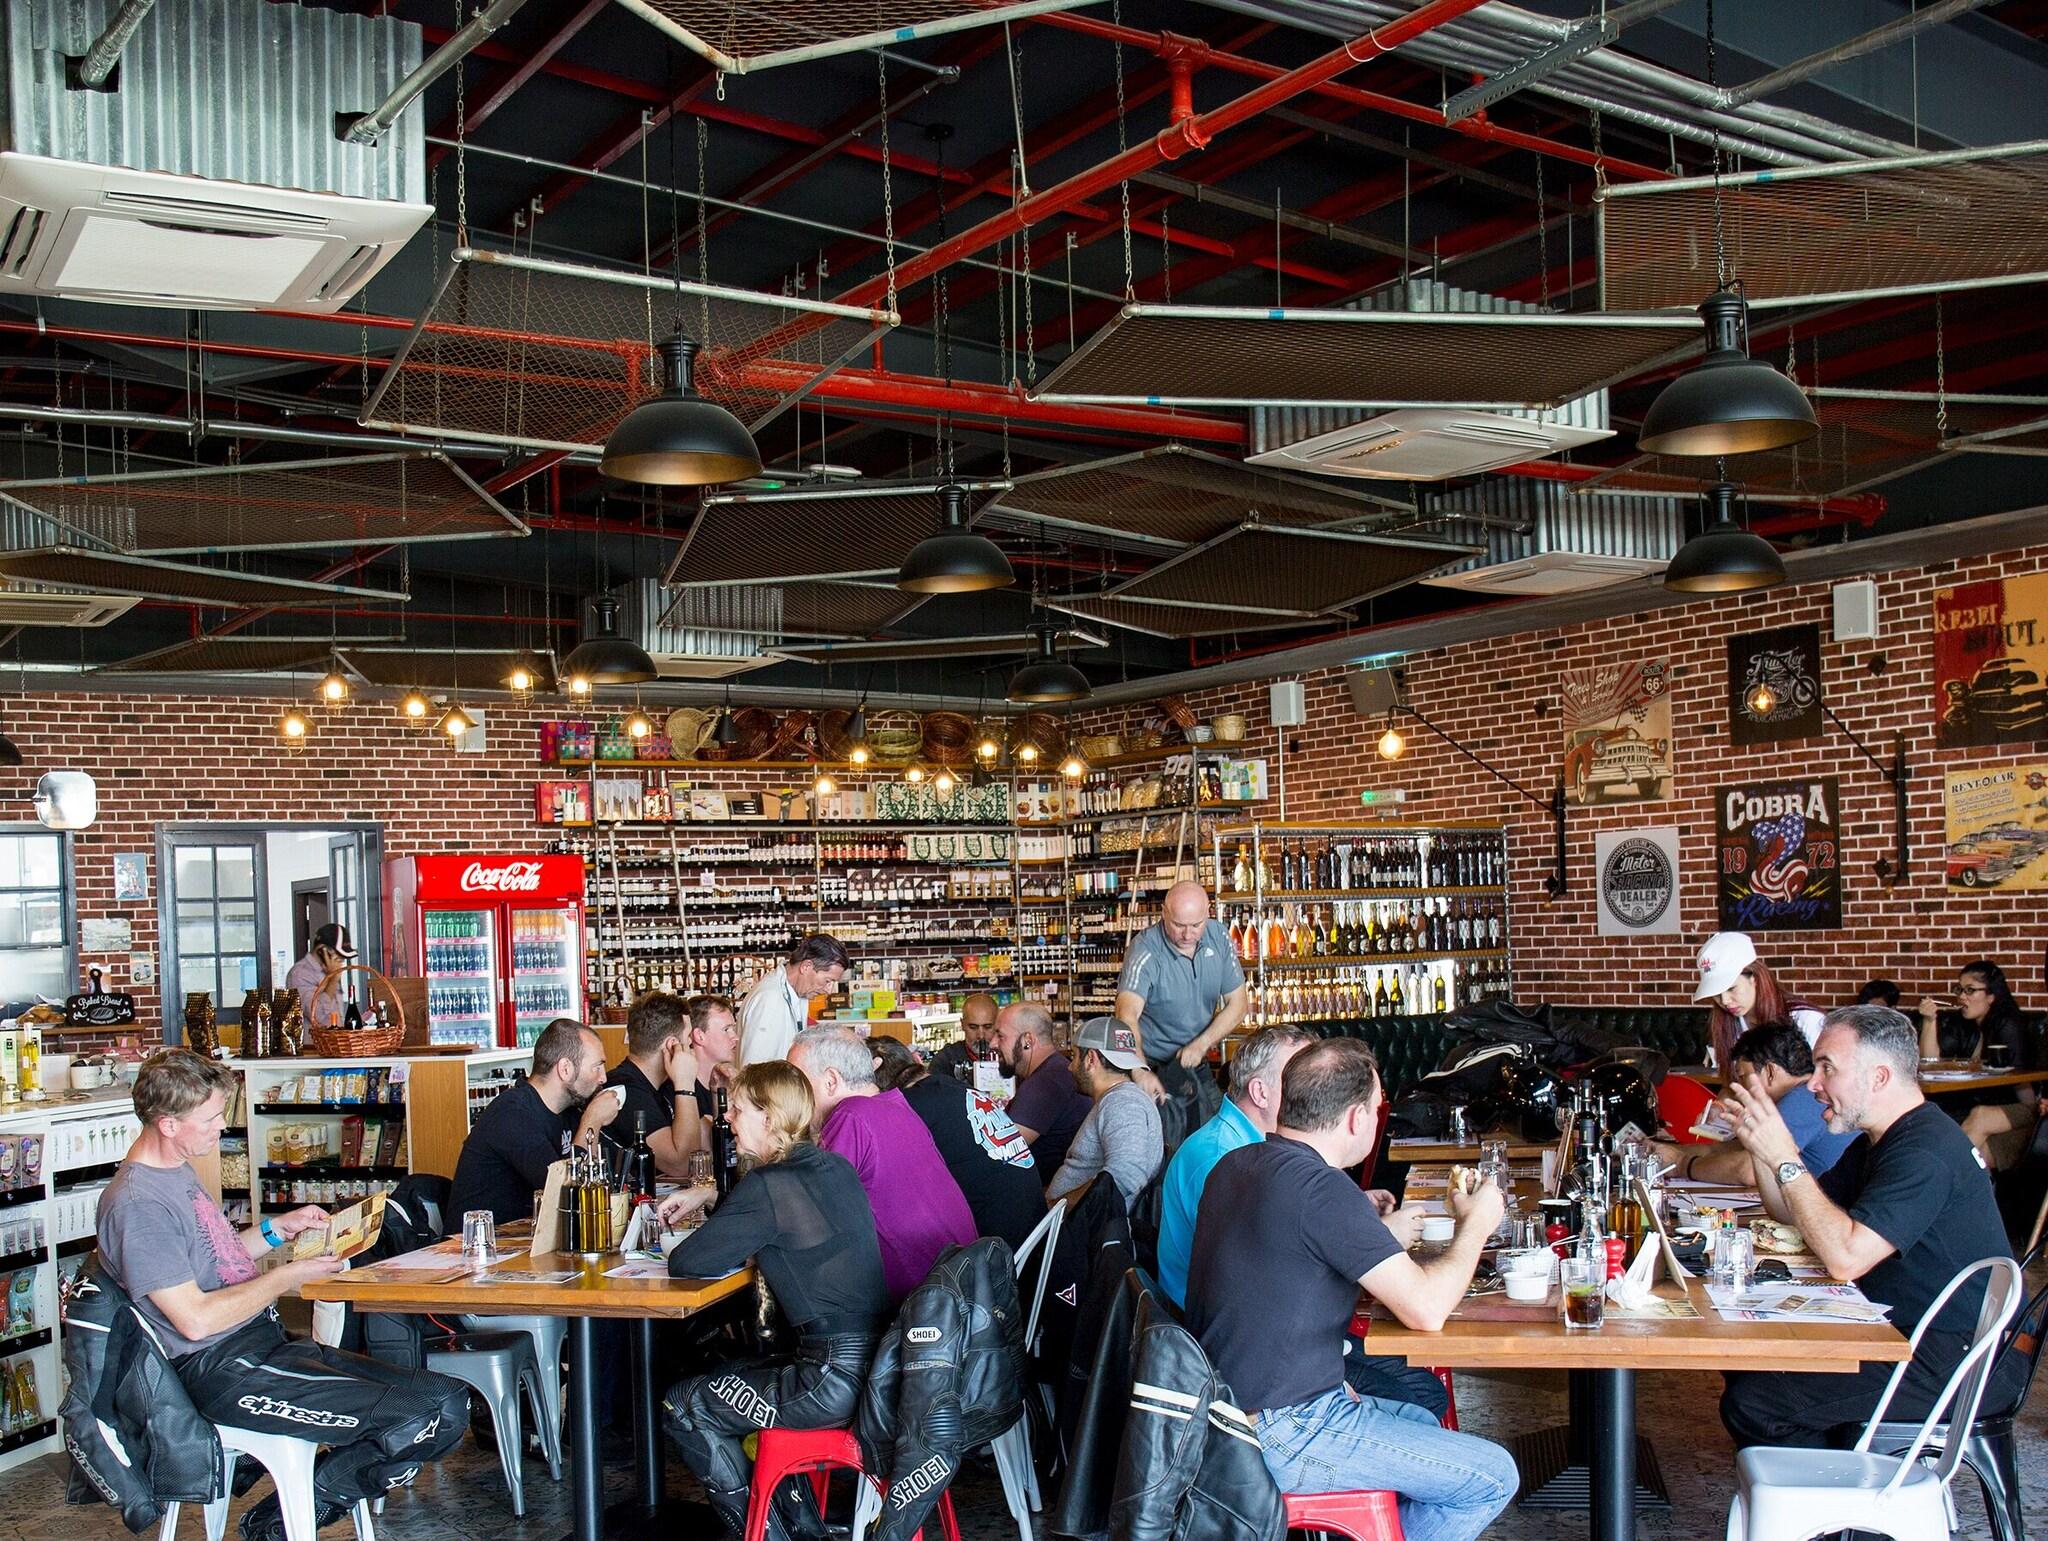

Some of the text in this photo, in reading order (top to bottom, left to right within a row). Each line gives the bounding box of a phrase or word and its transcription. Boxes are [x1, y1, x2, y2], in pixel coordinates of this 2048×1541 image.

[1595, 672, 1620, 689] Shop
[1646, 677, 1660, 691] 66
[1951, 779, 1980, 794] RENT
[1993, 771, 2016, 784] CAR
[1619, 854, 1656, 873] Motor
[1722, 841, 1836, 874] 19 72
[461, 862, 544, 892] Coca-Cola
[1615, 874, 1664, 890] RACING
[1620, 889, 1657, 902] DEALER
[1736, 893, 1821, 928] Racing
[77, 994, 123, 1010] Baked Bread
[912, 1330, 936, 1340] SHOEI
[238, 1394, 360, 1428] alpinestars
[708, 1373, 777, 1429] SHOEI
[889, 1454, 951, 1511] SHOEI
